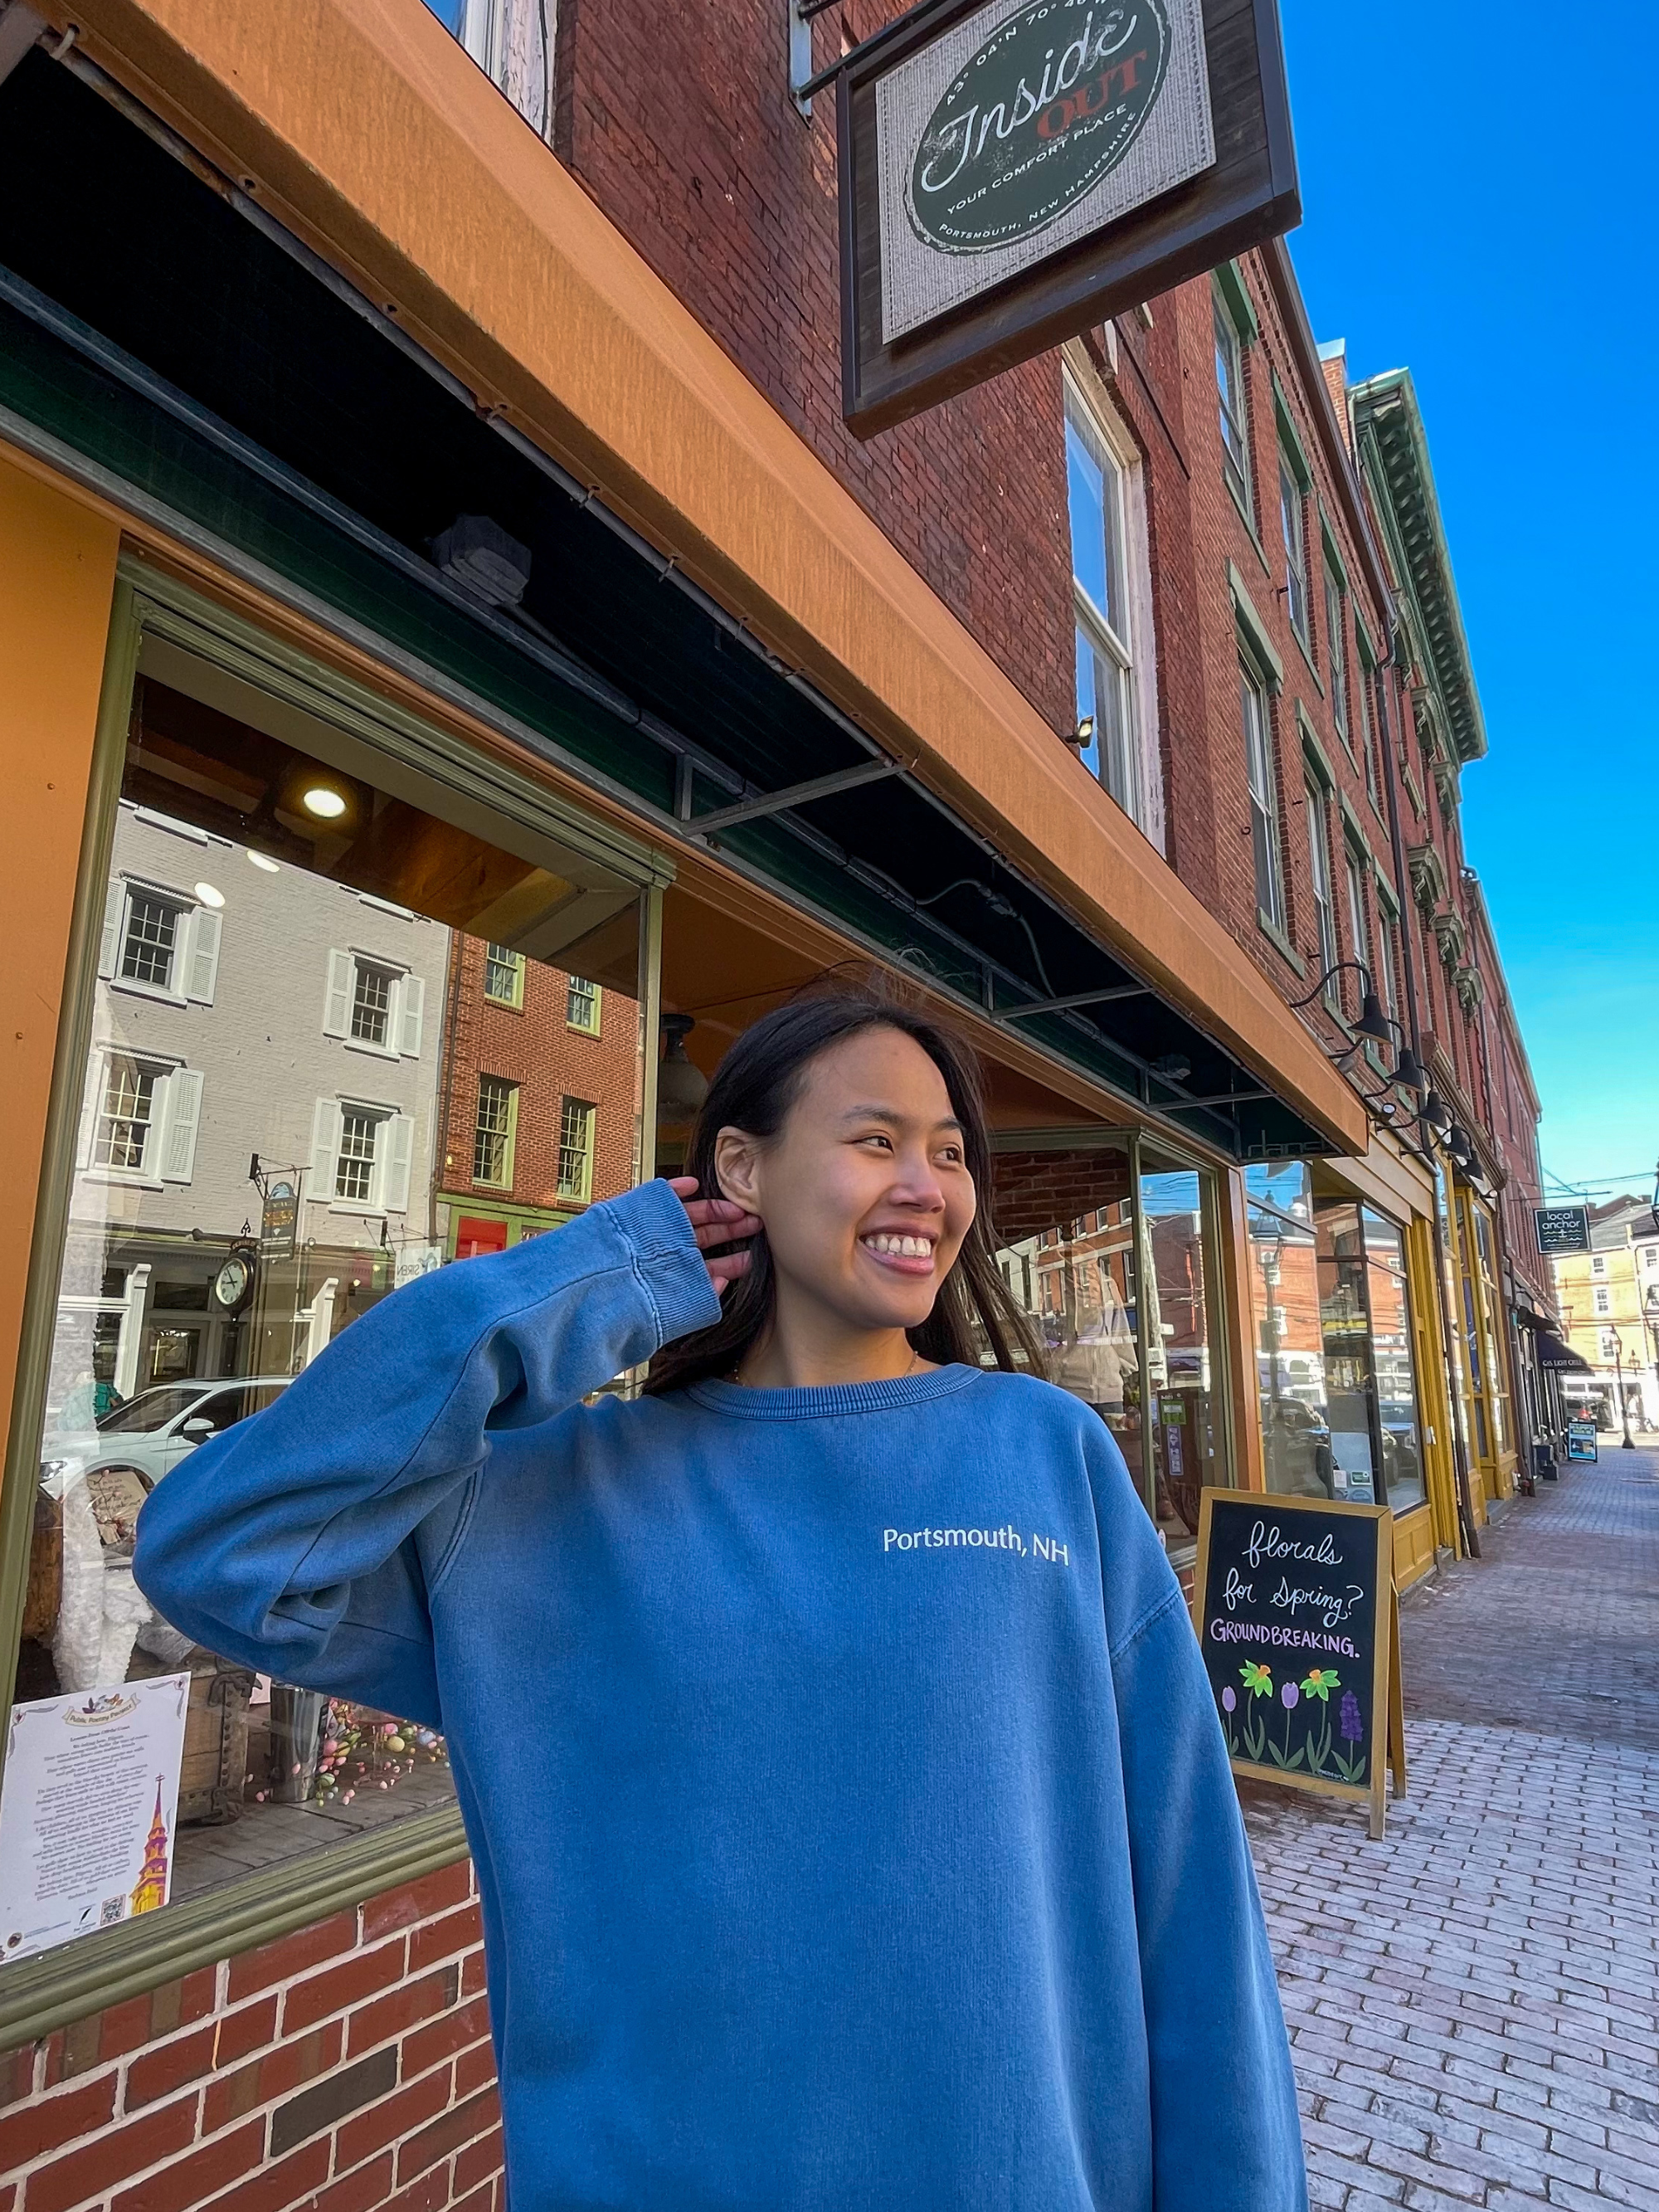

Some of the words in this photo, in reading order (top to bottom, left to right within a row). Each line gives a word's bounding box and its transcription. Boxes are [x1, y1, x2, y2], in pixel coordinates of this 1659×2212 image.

[921, 8, 1137, 192] Inside
[1036, 51, 1148, 140] OUT
[938, 222, 1022, 239] PORTSMOUTH,
[1029, 198, 1059, 222] NEW
[1064, 111, 1137, 197] HAMPSHIRE
[947, 187, 987, 215] YOUR
[991, 137, 1069, 189] COMFORT
[1073, 103, 1128, 140] PLACE
[1542, 1219, 1581, 1230] anchor
[1546, 1210, 1574, 1220] local
[883, 1524, 1028, 1557] Portsmouth,
[1034, 1532, 1069, 1566] NH
[1223, 1567, 1257, 1611] for
[1209, 1617, 1360, 1659] GROUNDBREAKING.
